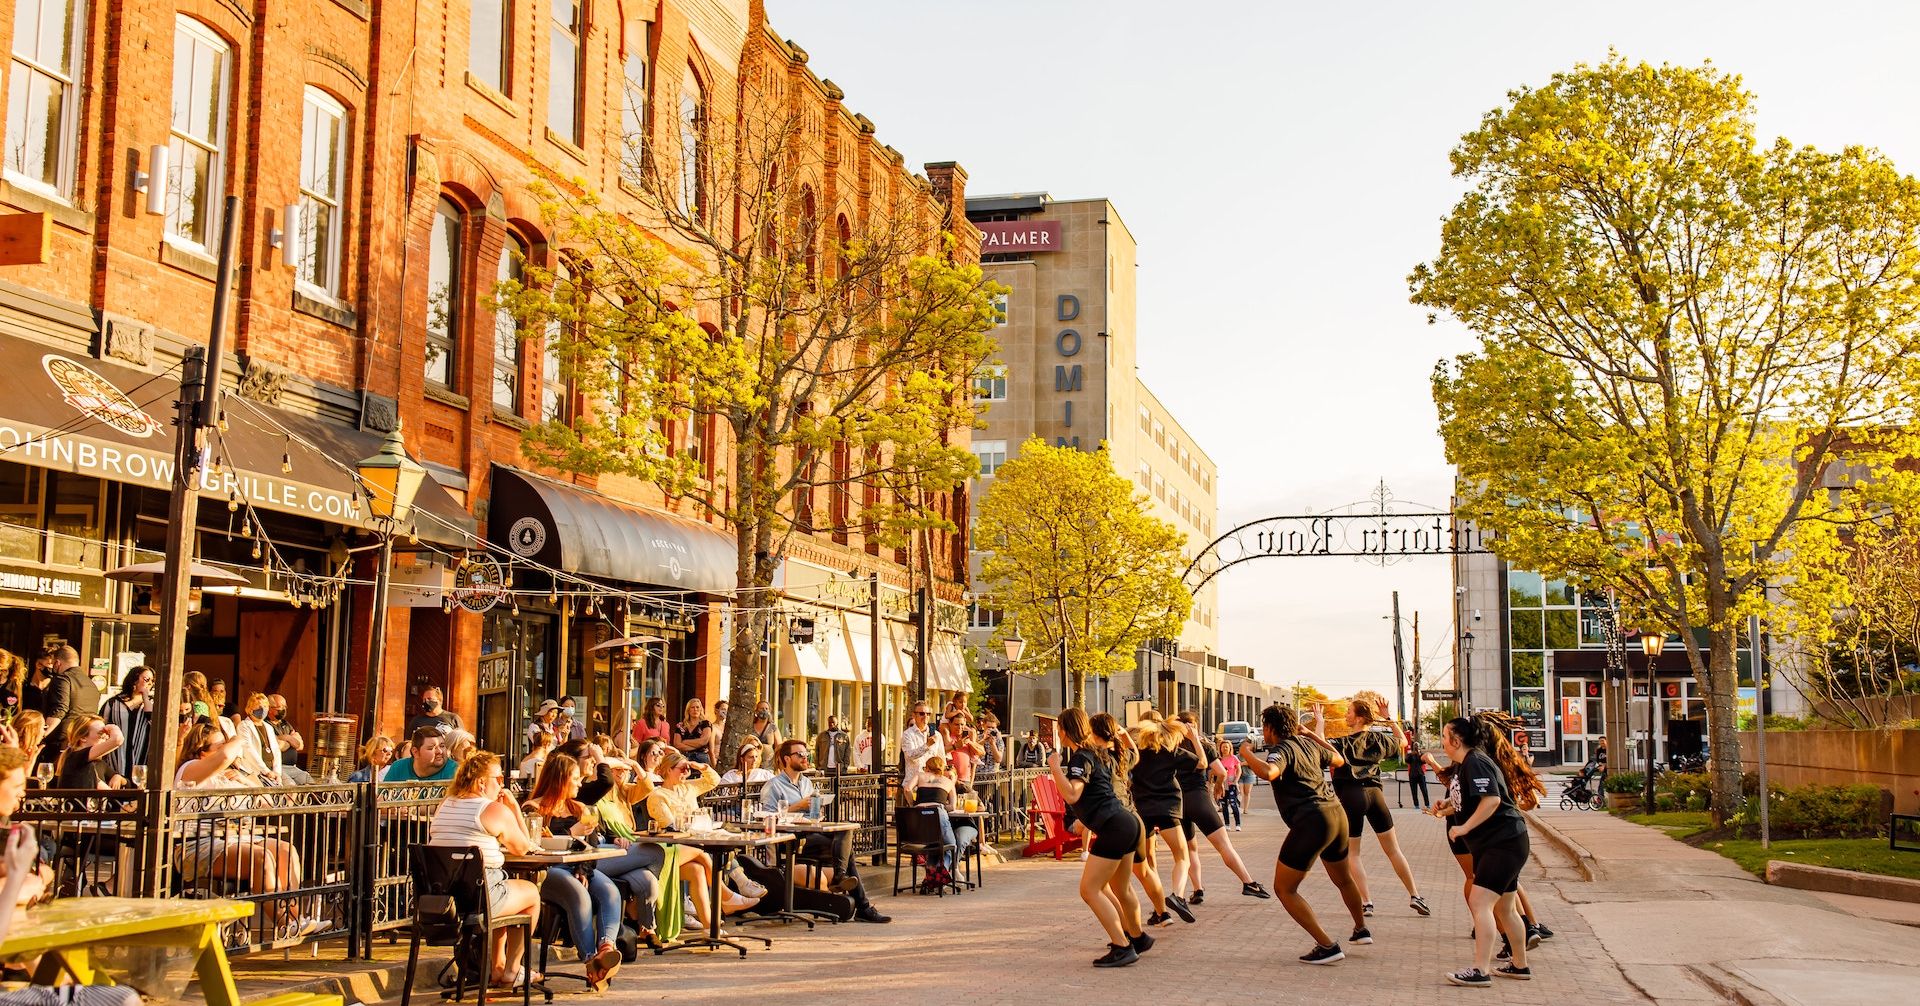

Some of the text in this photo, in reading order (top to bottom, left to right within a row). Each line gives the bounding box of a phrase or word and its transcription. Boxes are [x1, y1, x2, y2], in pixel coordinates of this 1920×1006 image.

[980, 230, 1051, 246] PALMER
[52, 578, 81, 597] GRILLE
[1588, 683, 1599, 696] G
[1666, 683, 1678, 697] G
